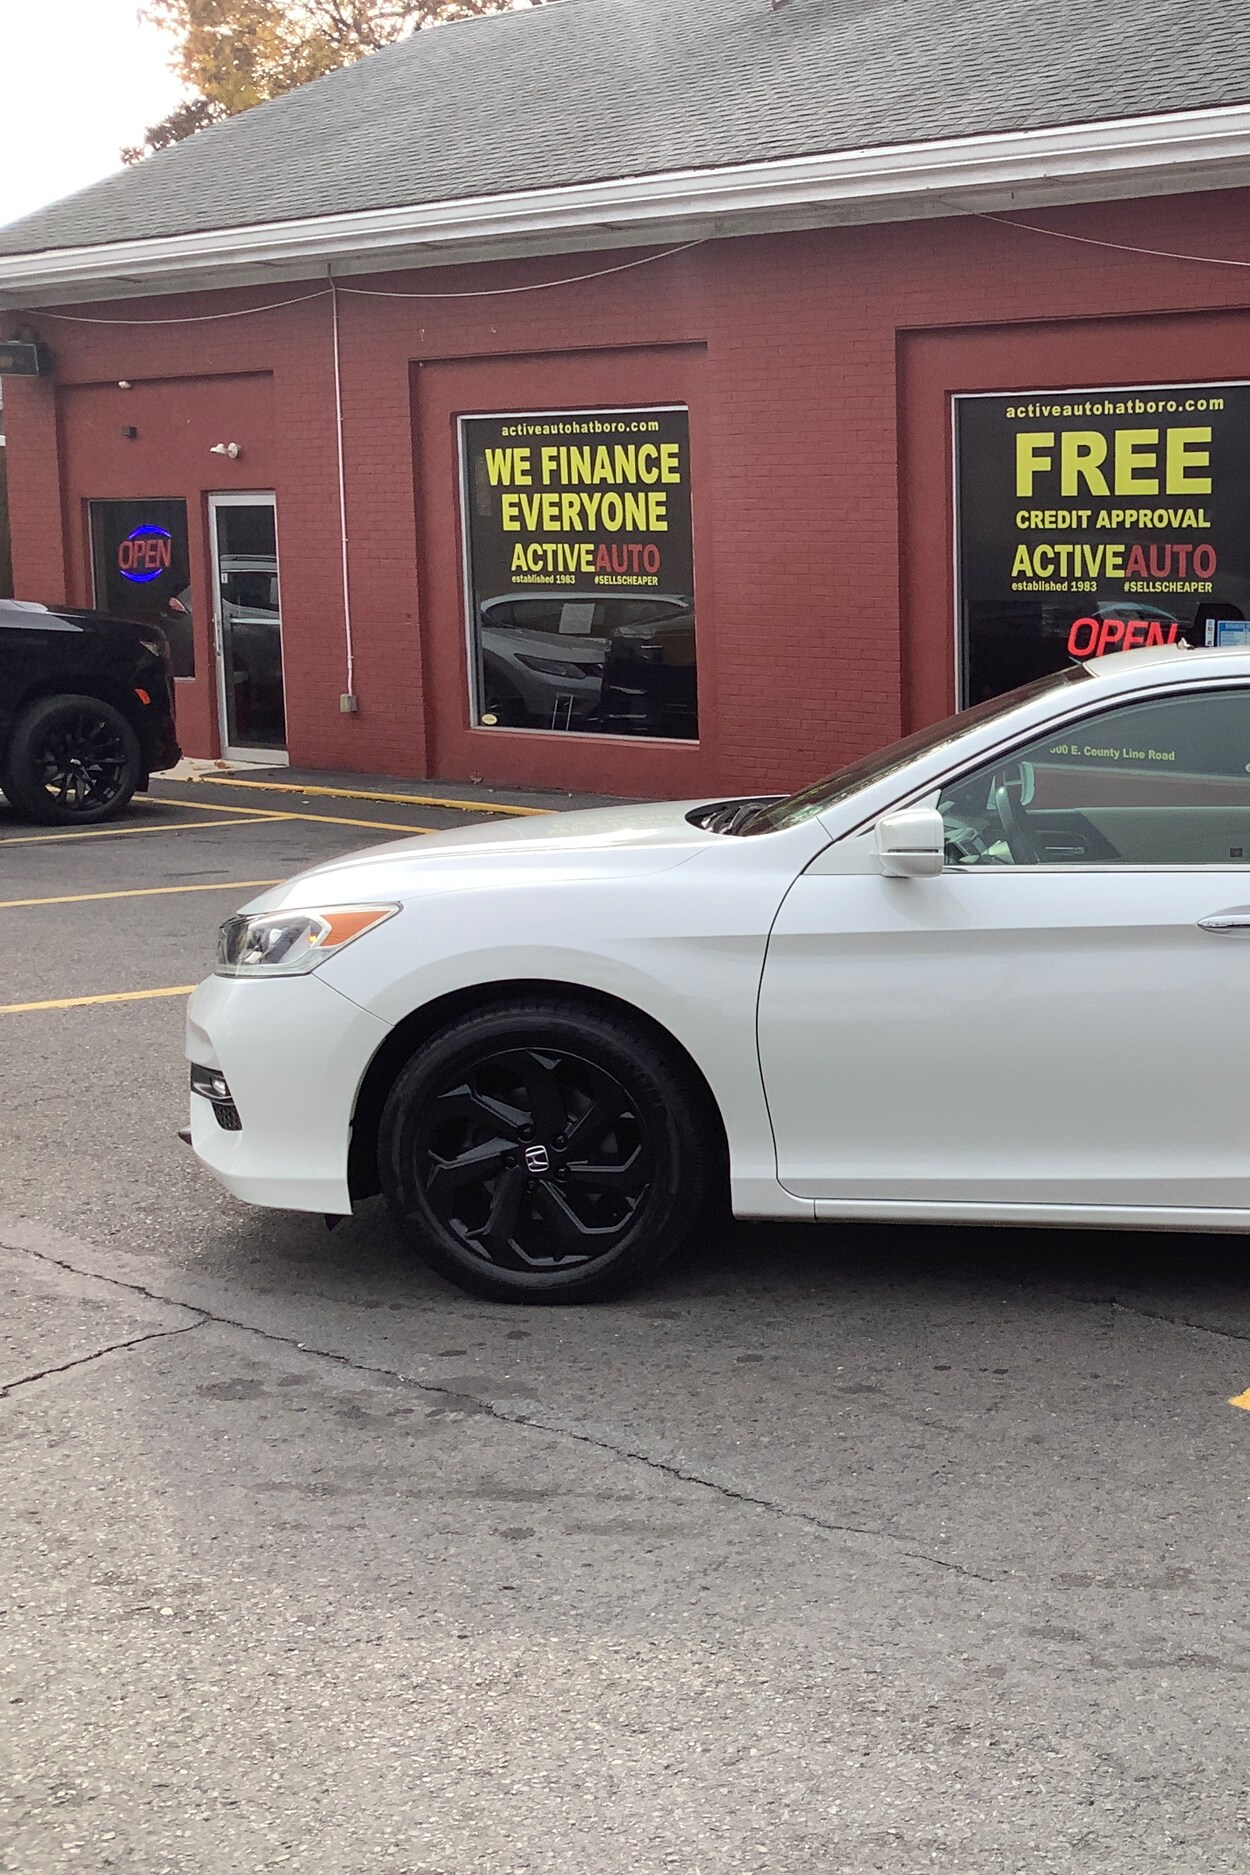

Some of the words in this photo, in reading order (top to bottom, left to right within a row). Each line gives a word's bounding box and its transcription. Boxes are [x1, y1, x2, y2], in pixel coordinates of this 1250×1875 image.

[1006, 397, 1224, 418] activeautohatboro.com
[501, 420, 659, 436] activeautohatboro.com
[485, 448, 532, 486] WE
[541, 444, 681, 485] FINANCE
[1016, 427, 1212, 497] FREE
[501, 491, 668, 532] EVERYONE
[1016, 510, 1092, 529] CREDIT
[1095, 509, 1211, 529] APPROVAL
[118, 539, 172, 569] OPEN
[511, 543, 661, 573] ACTIVEAUTO
[1011, 544, 1218, 579] ACTIVEAUTO
[511, 574, 554, 585] established
[556, 575, 576, 585] 1983
[594, 575, 659, 586] #SELLSCHEAPER
[1011, 581, 1068, 592] established
[1070, 581, 1098, 592] 1983
[1124, 581, 1213, 593] #SELLSCHEAPER
[1067, 617, 1178, 657] OPEN
[1071, 746, 1081, 755] E.
[1084, 746, 1120, 760] County
[1123, 748, 1145, 759] Line
[1149, 750, 1176, 760] Road
